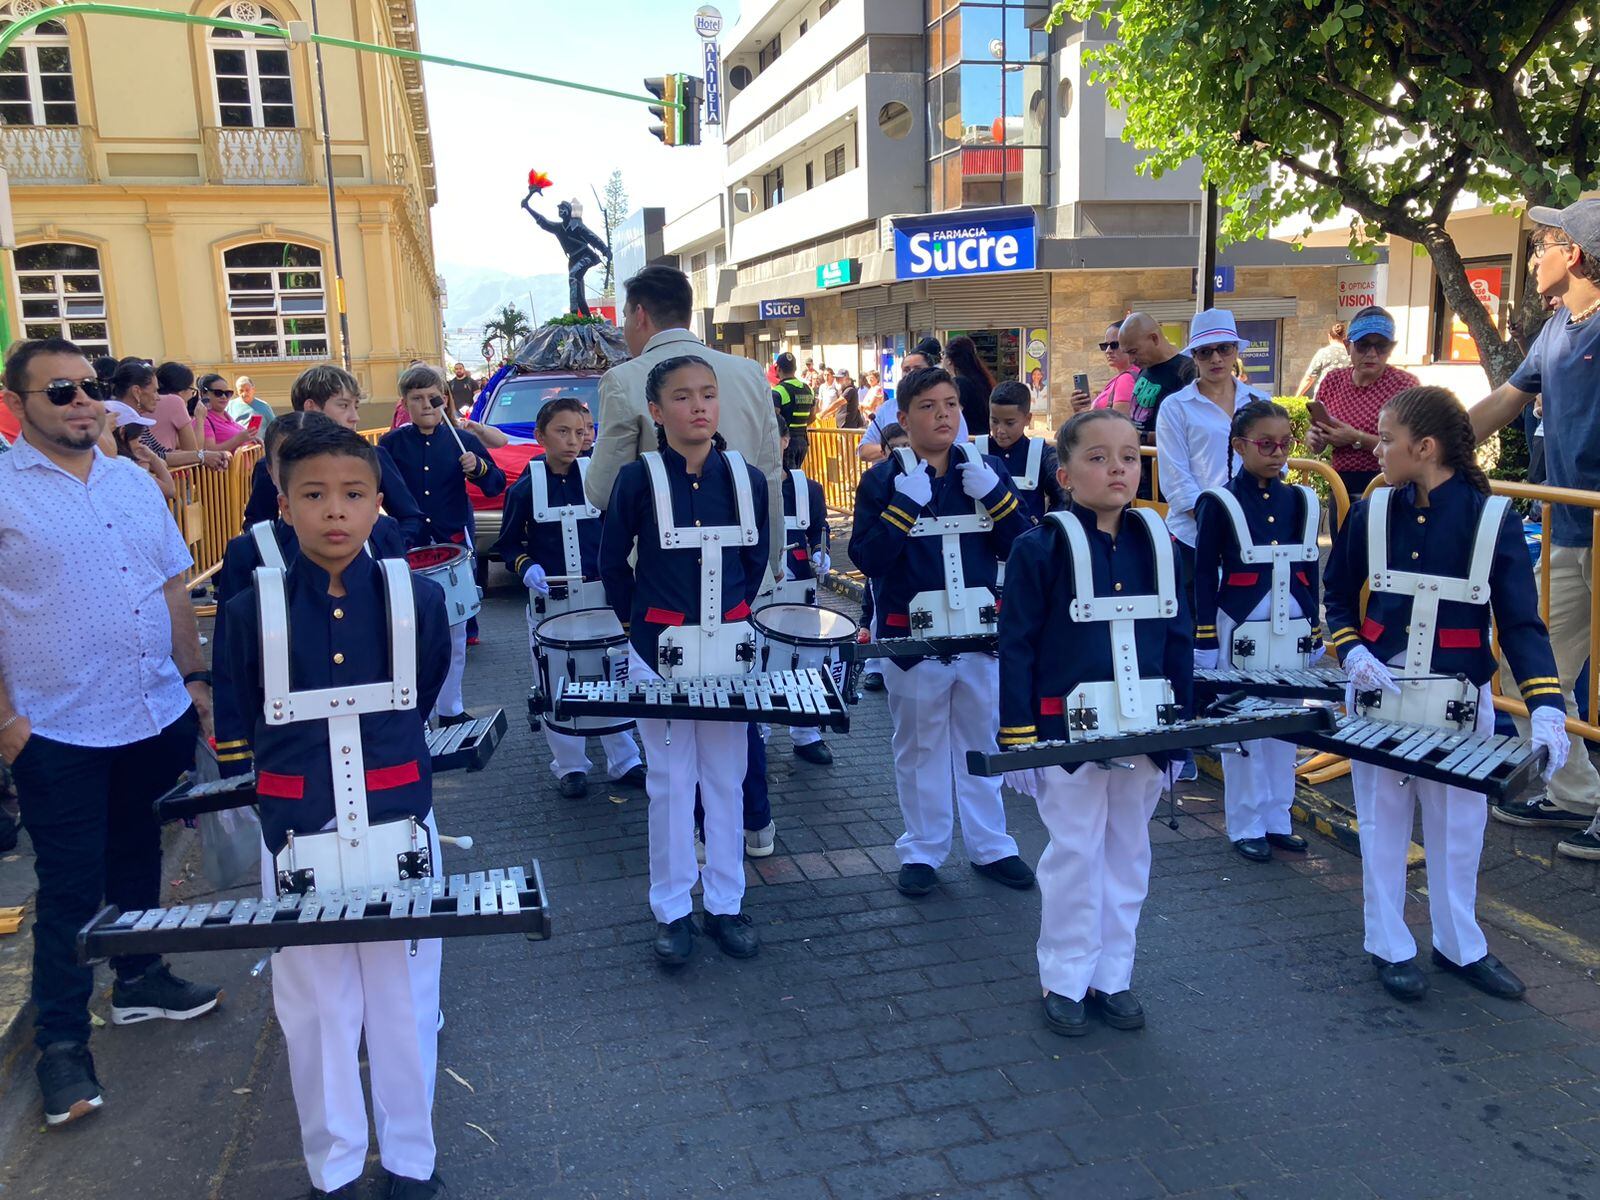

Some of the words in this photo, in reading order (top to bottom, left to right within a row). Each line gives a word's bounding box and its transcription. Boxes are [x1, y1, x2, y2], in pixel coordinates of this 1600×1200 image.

[697, 17, 720, 29] Hotel
[706, 43, 718, 121] ALAJUELA
[933, 227, 987, 241] FARMACIA
[909, 232, 1019, 274] Sucre
[1348, 281, 1375, 290] OPTICAS
[1338, 294, 1375, 307] VISION
[765, 302, 800, 315] Sucre
